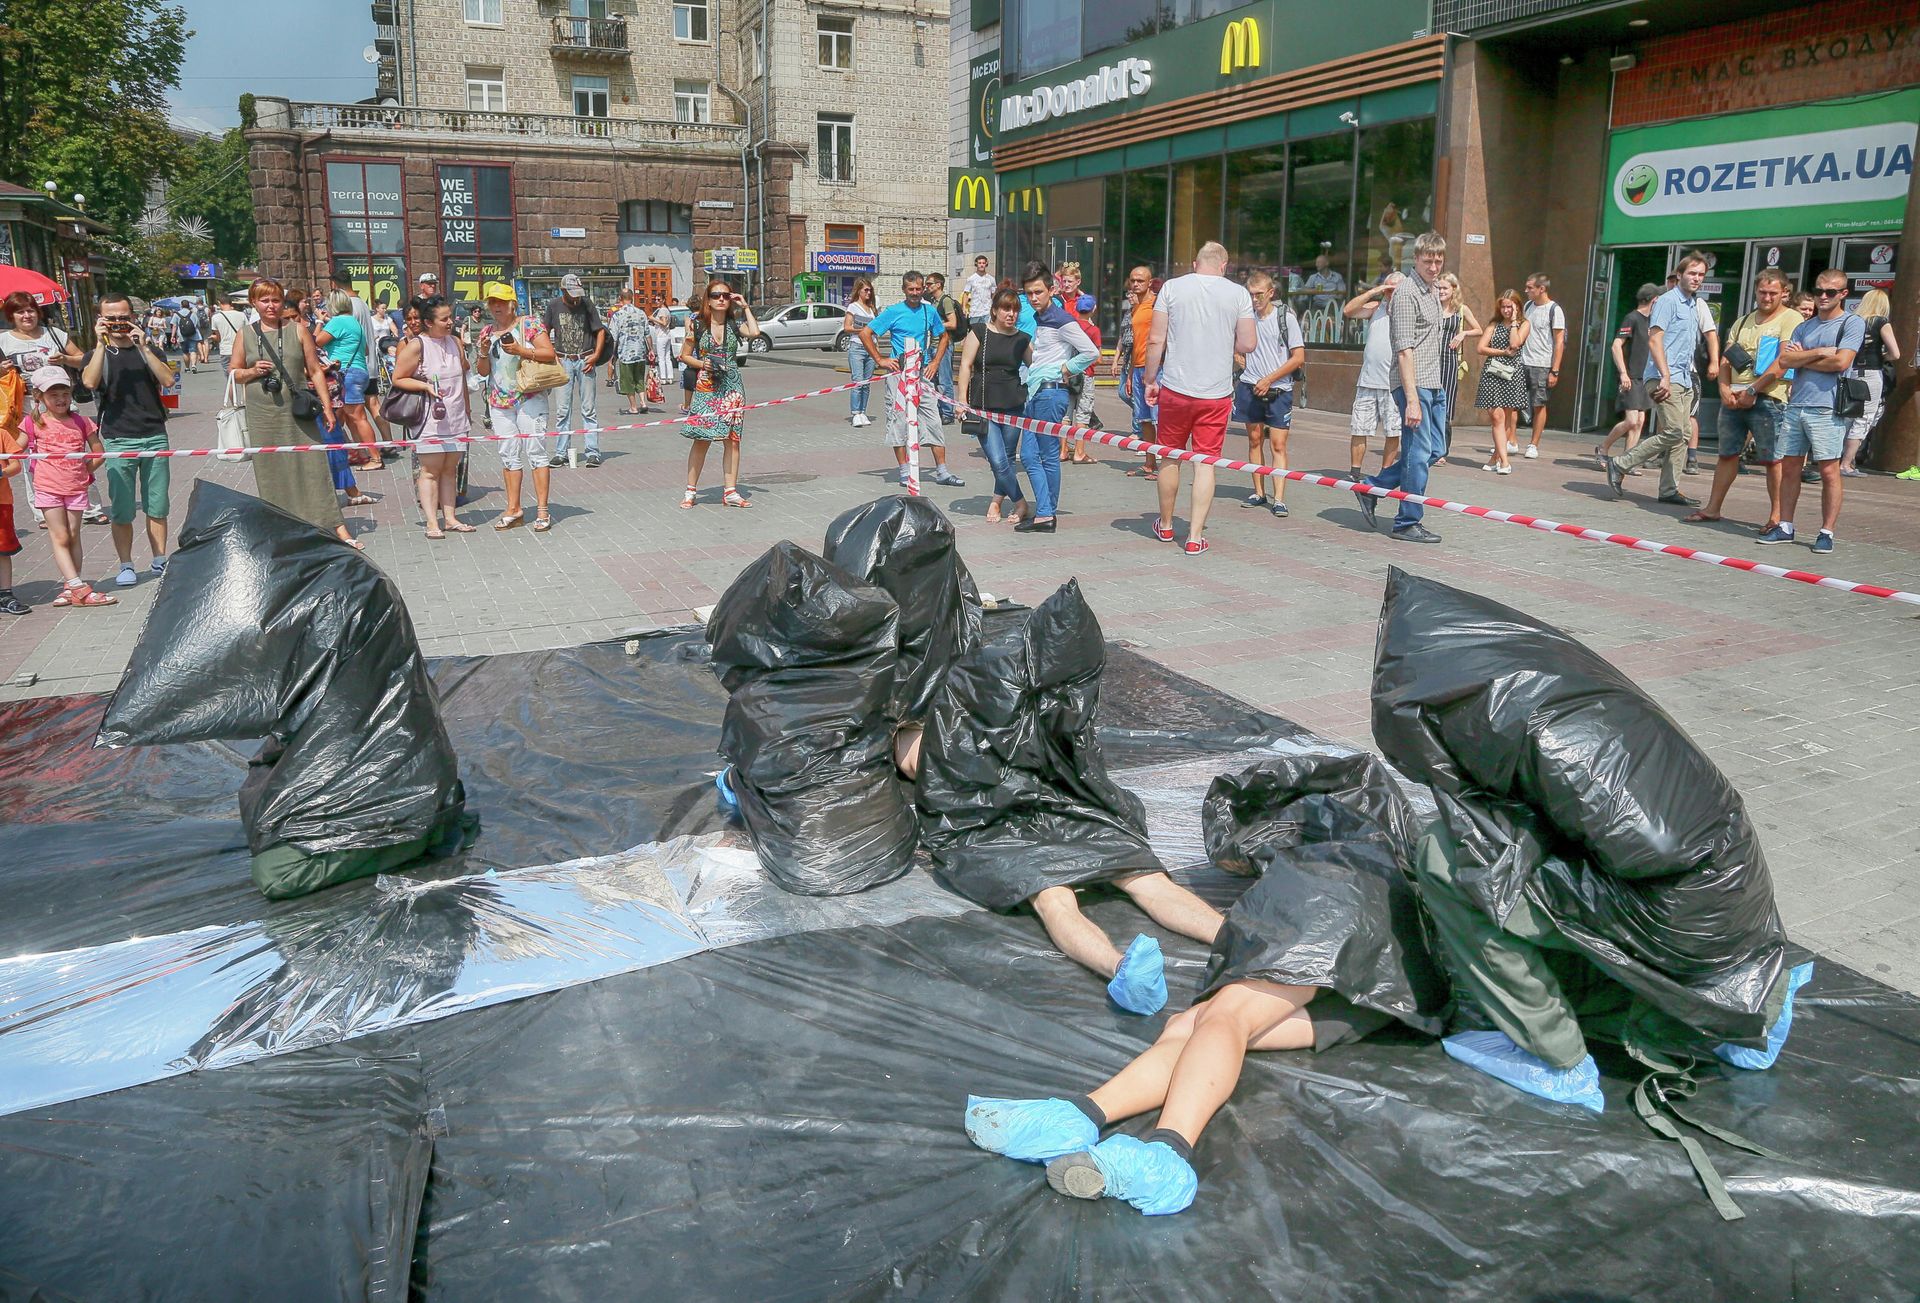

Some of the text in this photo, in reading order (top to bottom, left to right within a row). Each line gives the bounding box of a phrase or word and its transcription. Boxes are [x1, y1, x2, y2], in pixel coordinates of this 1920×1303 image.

[1782, 26, 1902, 68] ВХОДУ
[1000, 57, 1152, 132] McDonald's
[1664, 143, 1914, 195] ROZETKA.UA
[440, 178, 465, 190] WE
[441, 192, 473, 204] ARE
[442, 205, 463, 217] AS
[444, 219, 475, 230] YOU
[444, 231, 475, 243] ARE
